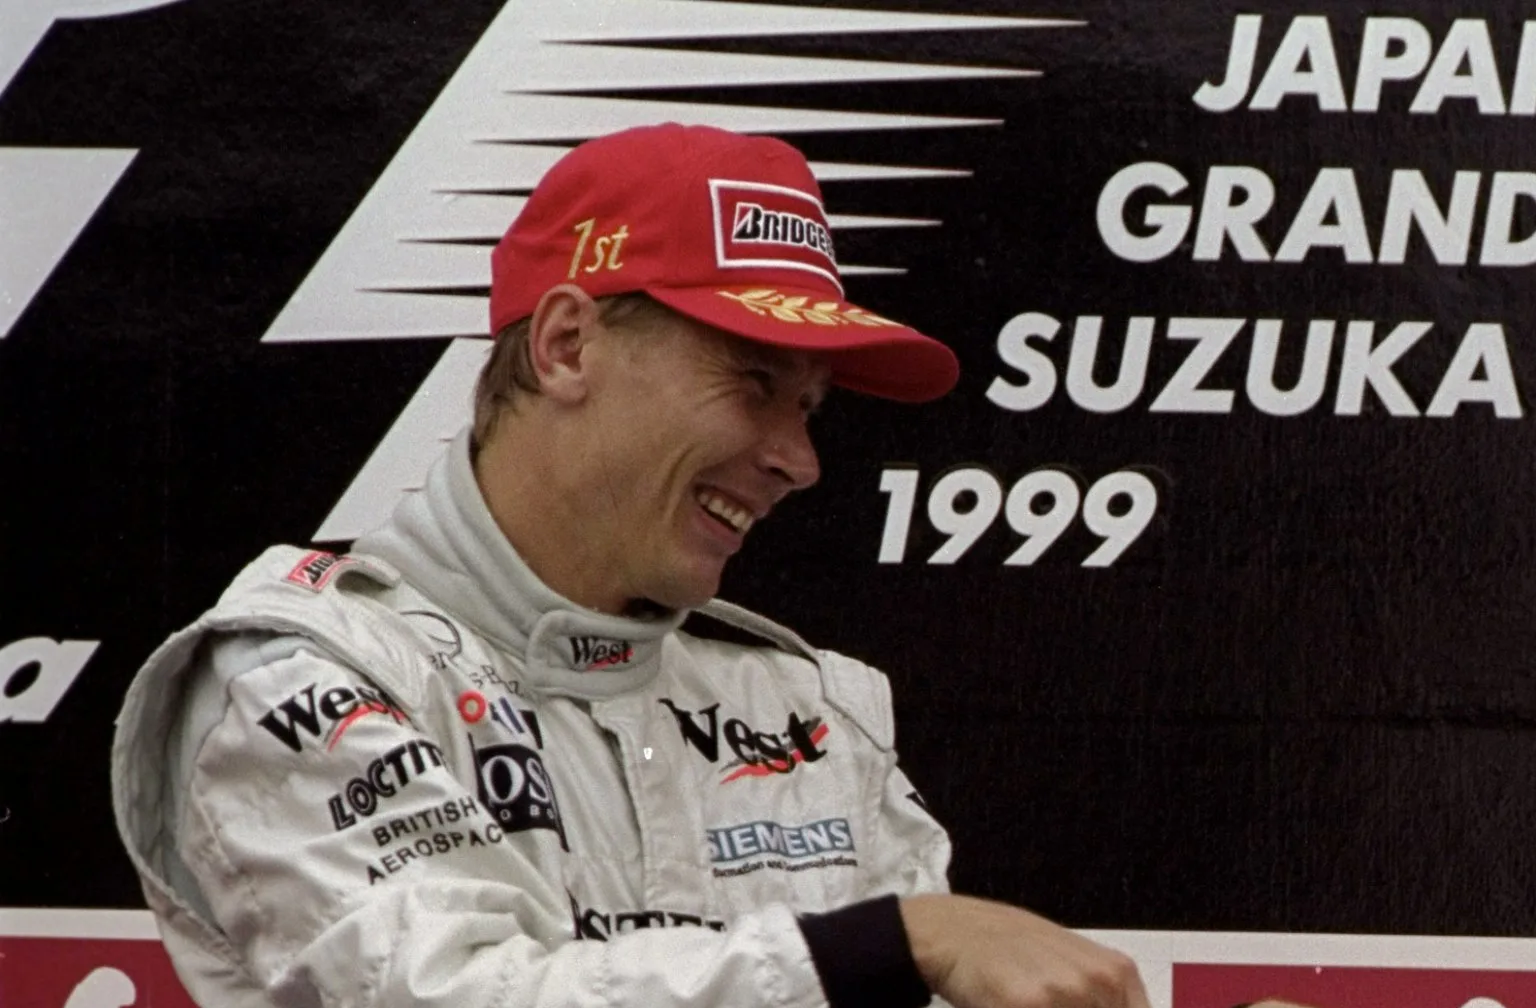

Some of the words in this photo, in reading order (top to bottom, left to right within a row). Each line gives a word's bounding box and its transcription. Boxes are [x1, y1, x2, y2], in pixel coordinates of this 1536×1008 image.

[568, 217, 629, 279] 1st
[986, 312, 1523, 418] SUZUKA
[877, 468, 1157, 567] 1999
[328, 738, 448, 831] LOCTIT
[371, 795, 479, 848] BRITISH
[366, 823, 504, 885] AEROSPAC
